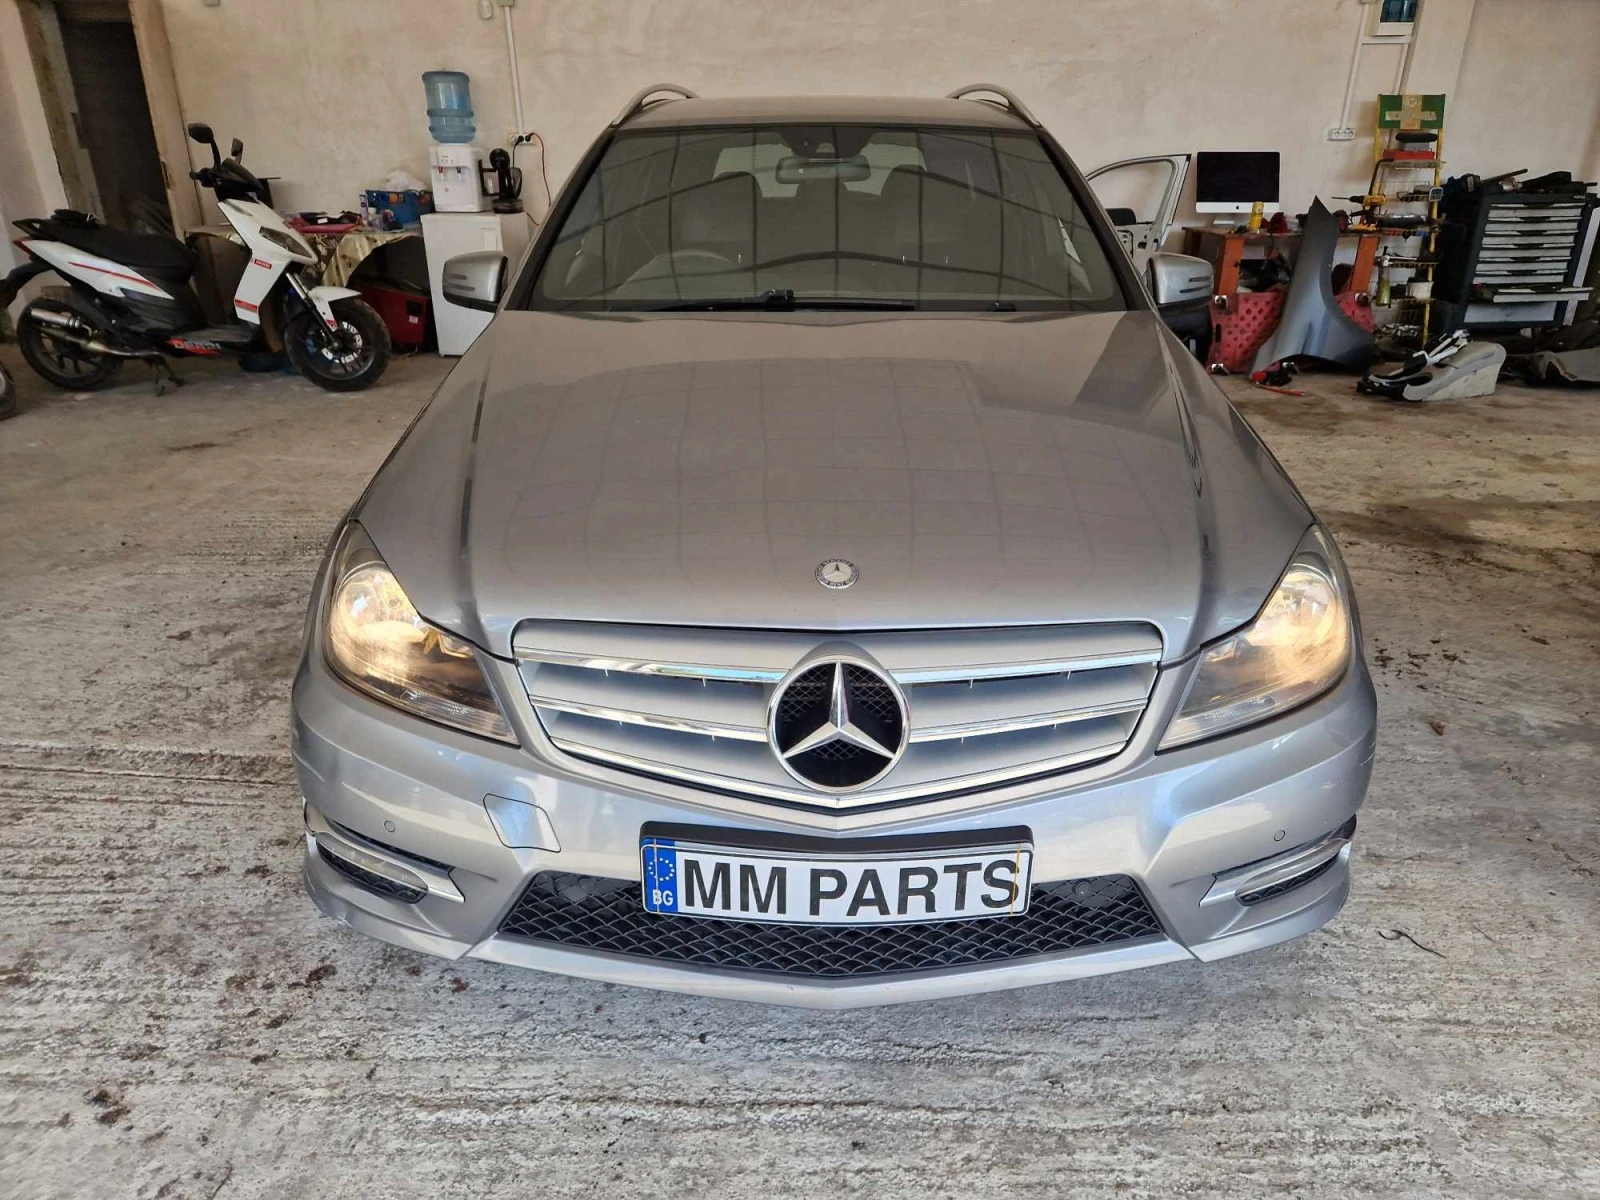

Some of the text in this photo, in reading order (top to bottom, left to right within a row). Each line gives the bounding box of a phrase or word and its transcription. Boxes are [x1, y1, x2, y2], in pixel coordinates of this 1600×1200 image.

[652, 889, 674, 906] BG
[684, 858, 1020, 917] MM PARTS
